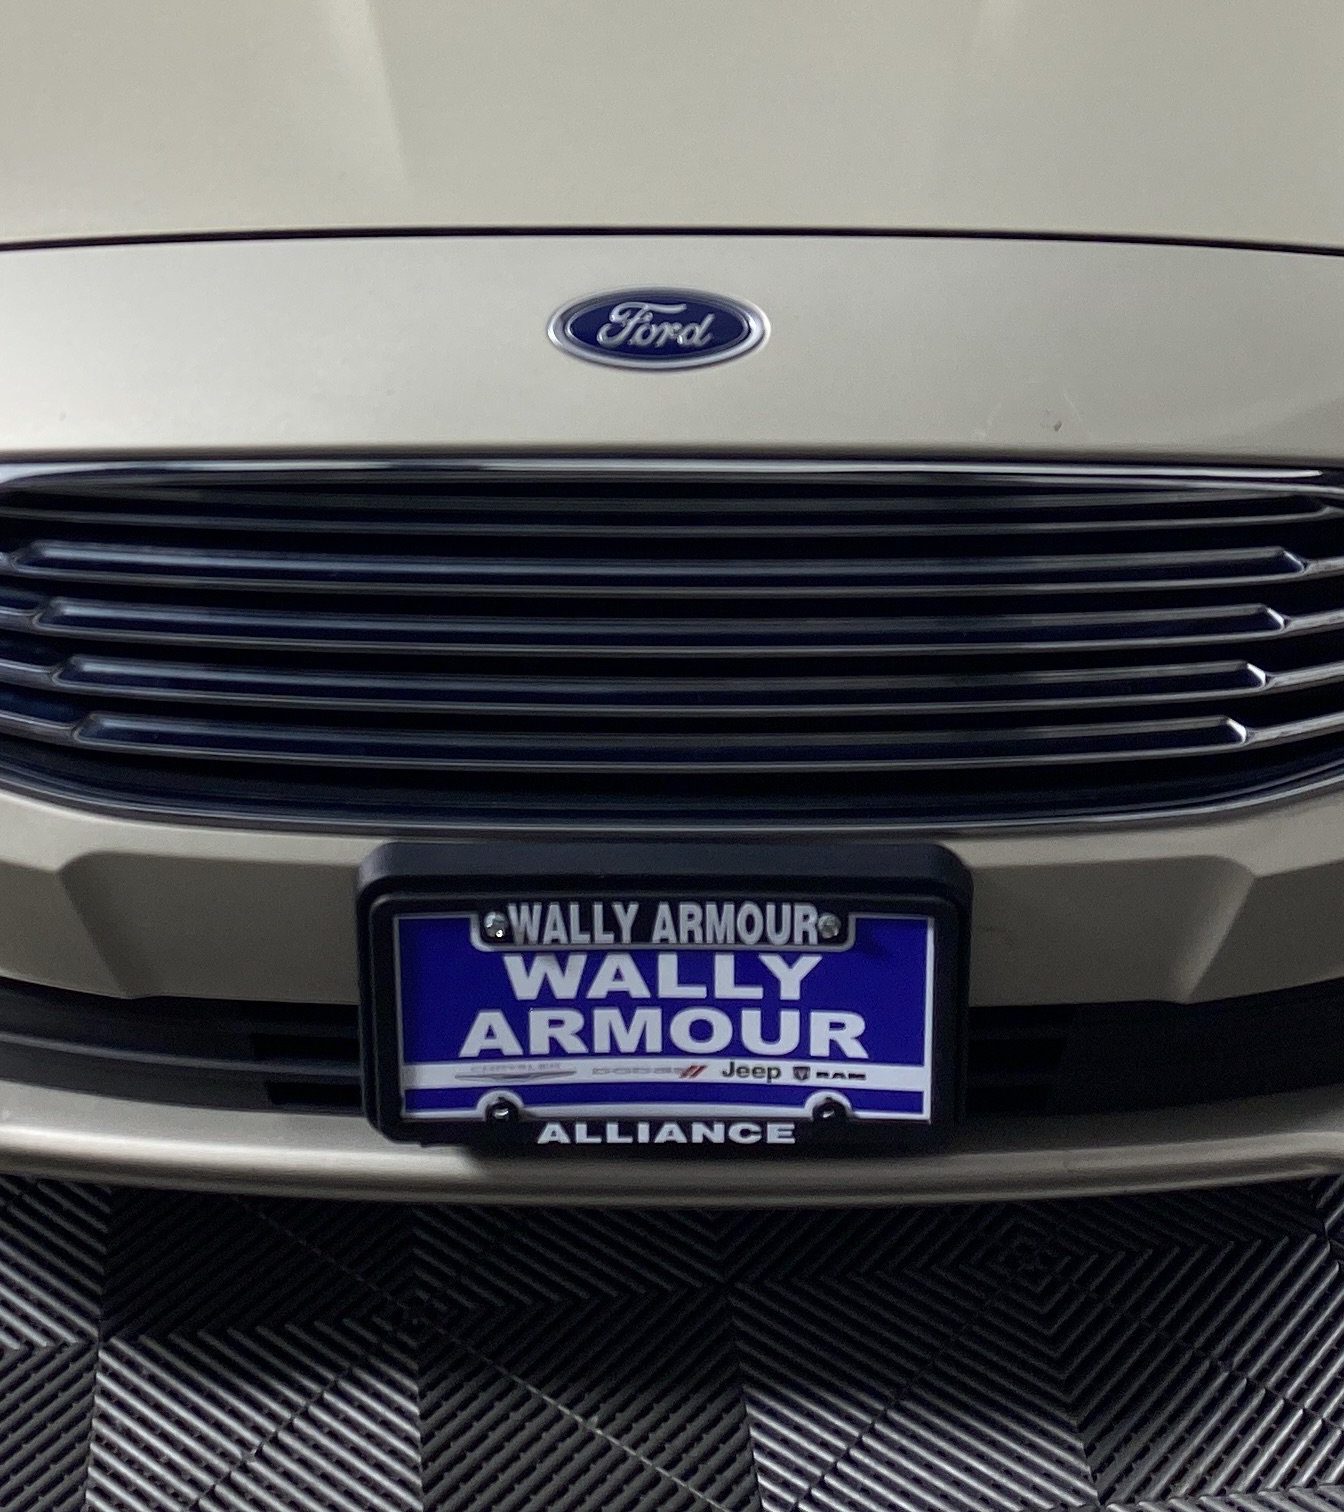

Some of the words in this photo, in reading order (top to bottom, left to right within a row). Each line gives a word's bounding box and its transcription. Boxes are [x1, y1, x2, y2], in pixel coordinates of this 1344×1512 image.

[596, 301, 716, 348] Ford
[506, 901, 639, 945] WALLY
[652, 901, 819, 945] ARMOUR
[503, 952, 823, 1001] WALLY
[458, 1007, 870, 1060] ARMOUR
[722, 1061, 782, 1083] Jeep
[537, 1120, 796, 1145] ALLIANCE
